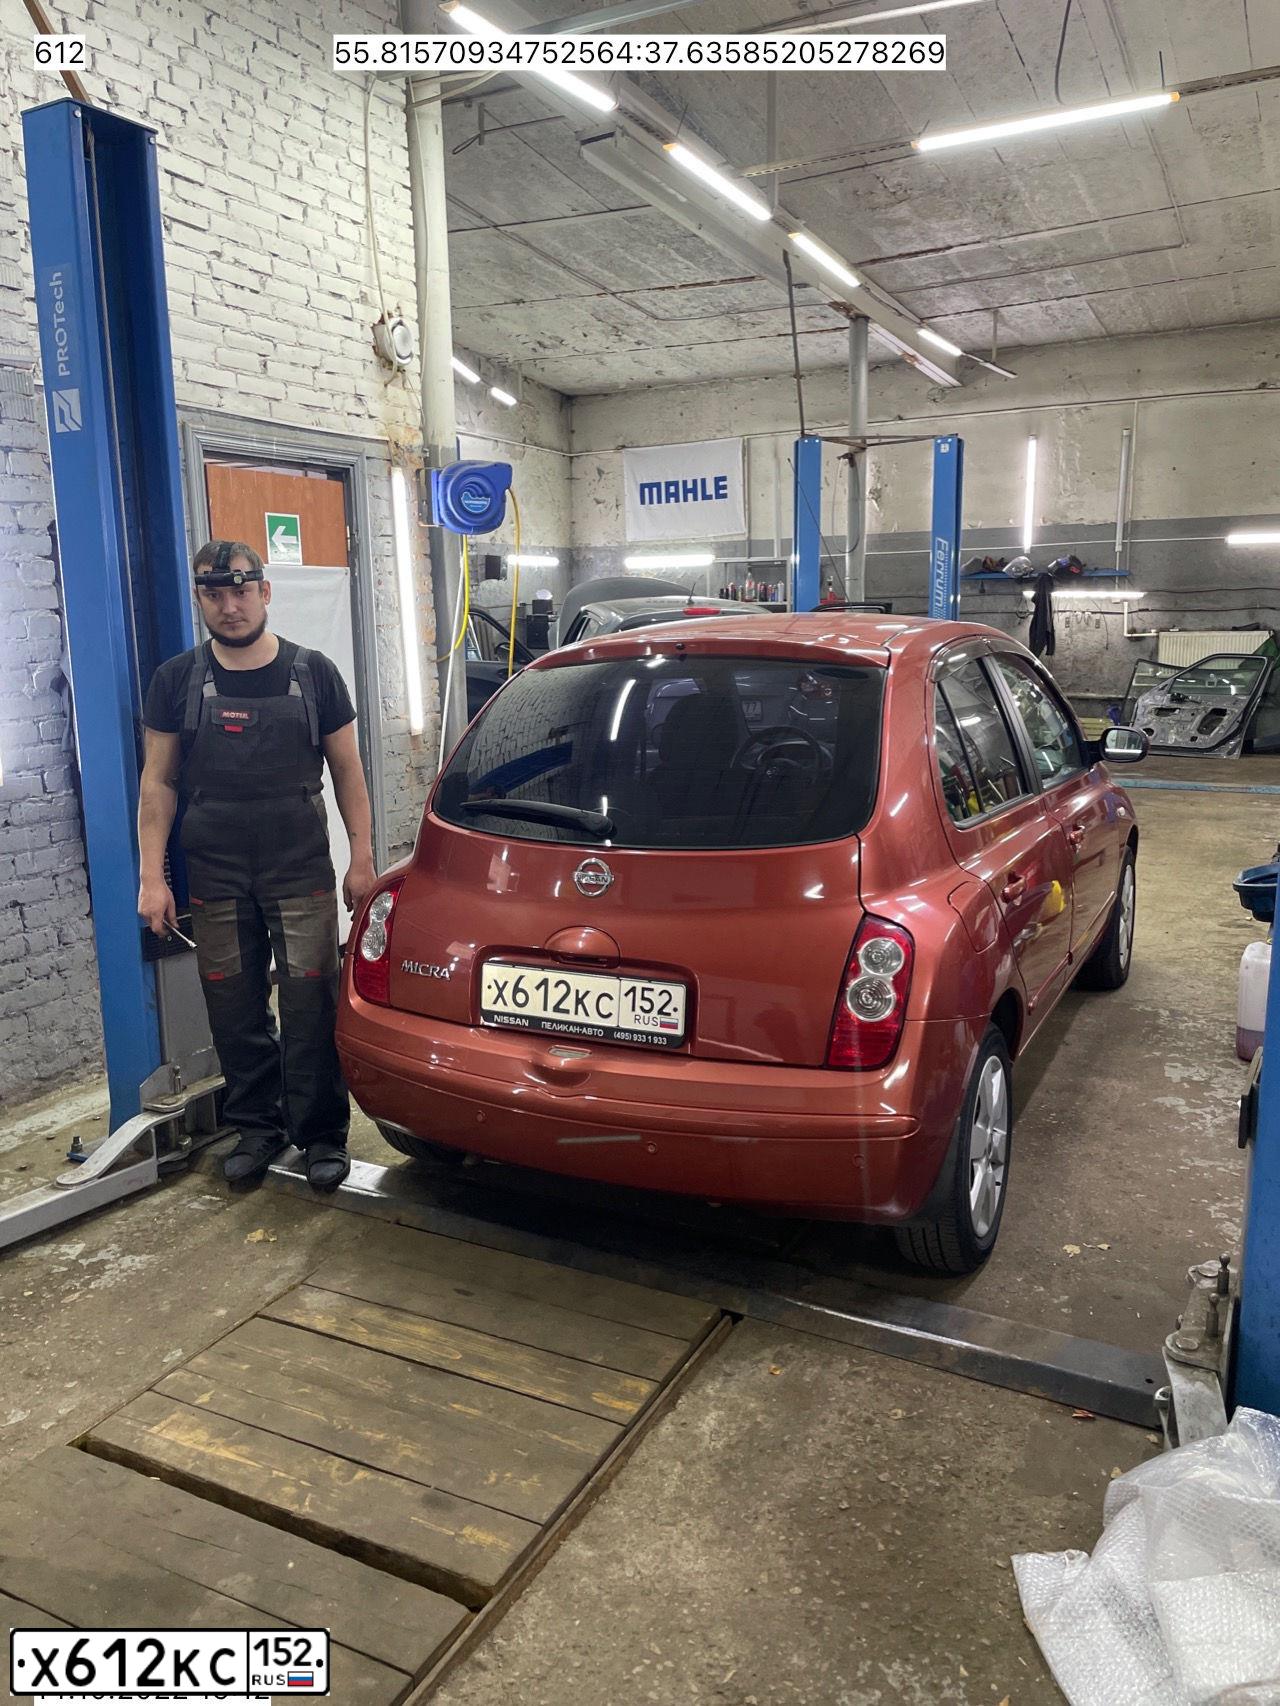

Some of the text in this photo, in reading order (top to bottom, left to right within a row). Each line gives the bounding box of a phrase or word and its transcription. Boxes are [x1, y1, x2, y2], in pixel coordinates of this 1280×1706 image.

[49, 272, 71, 377] PROTech
[639, 475, 728, 506] MAHLE
[935, 537, 949, 608] Ferrum
[401, 960, 451, 981] MICRA
[624, 986, 672, 1017] 152
[493, 1014, 529, 1027] NISSAN
[541, 1021, 604, 1037] ПЕЛИКАН-АВТО
[613, 1031, 632, 1041] (495)
[633, 1033, 647, 1042] 933
[652, 1035, 667, 1045] 933
[634, 1014, 659, 1027] RUS
